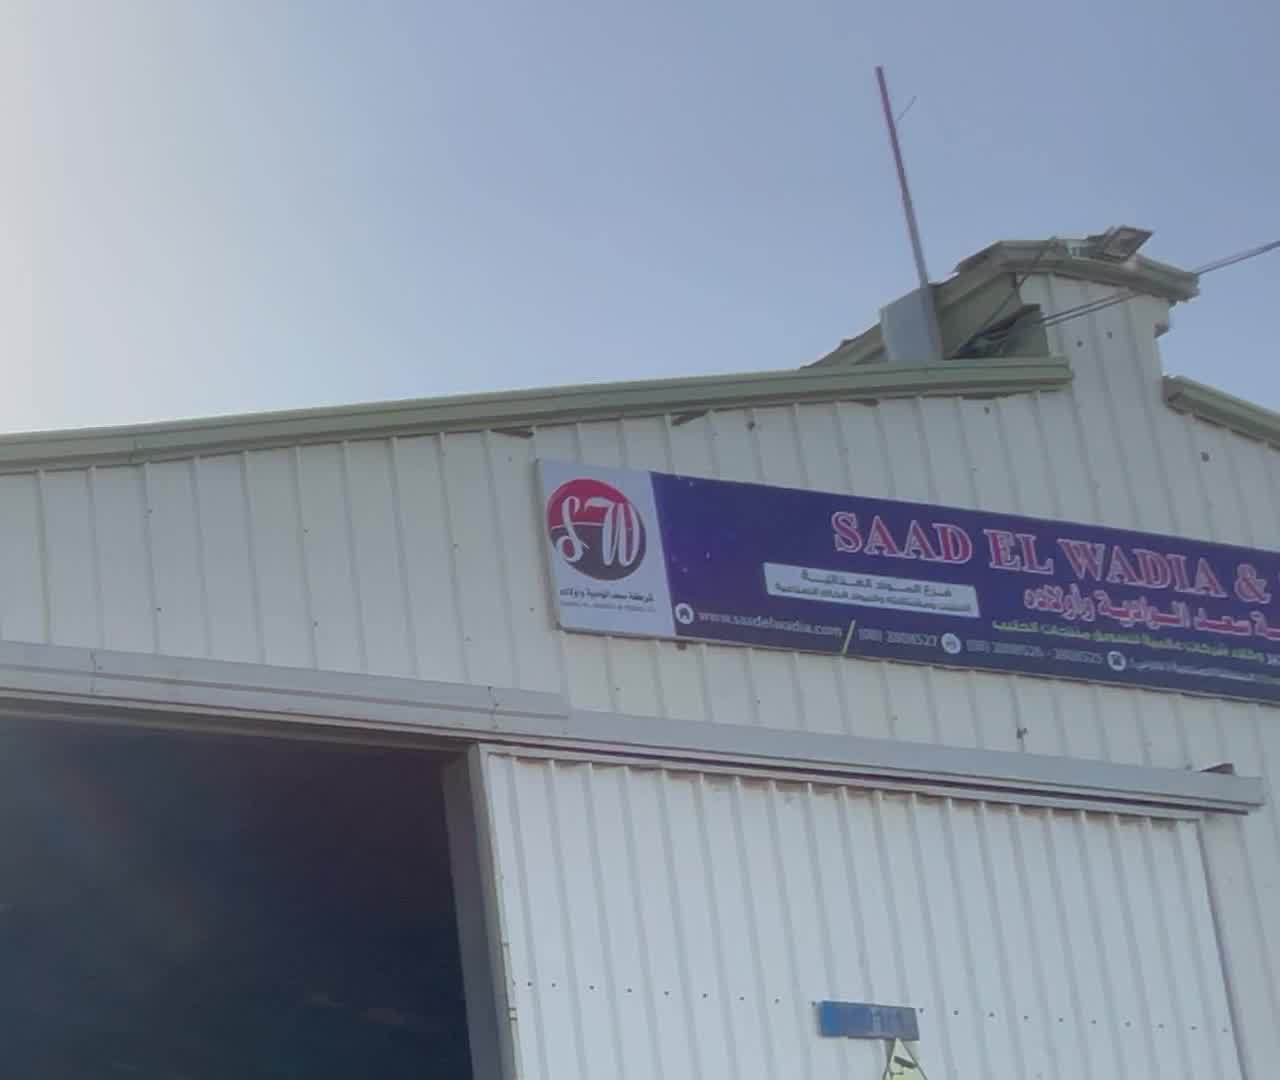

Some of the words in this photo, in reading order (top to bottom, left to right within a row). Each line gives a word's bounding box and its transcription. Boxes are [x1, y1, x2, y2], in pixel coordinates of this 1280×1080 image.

[831, 511, 973, 565] SAAD
[983, 528, 1054, 576] EL
[1057, 538, 1229, 599] WADIA
[1234, 563, 1272, 604] &
